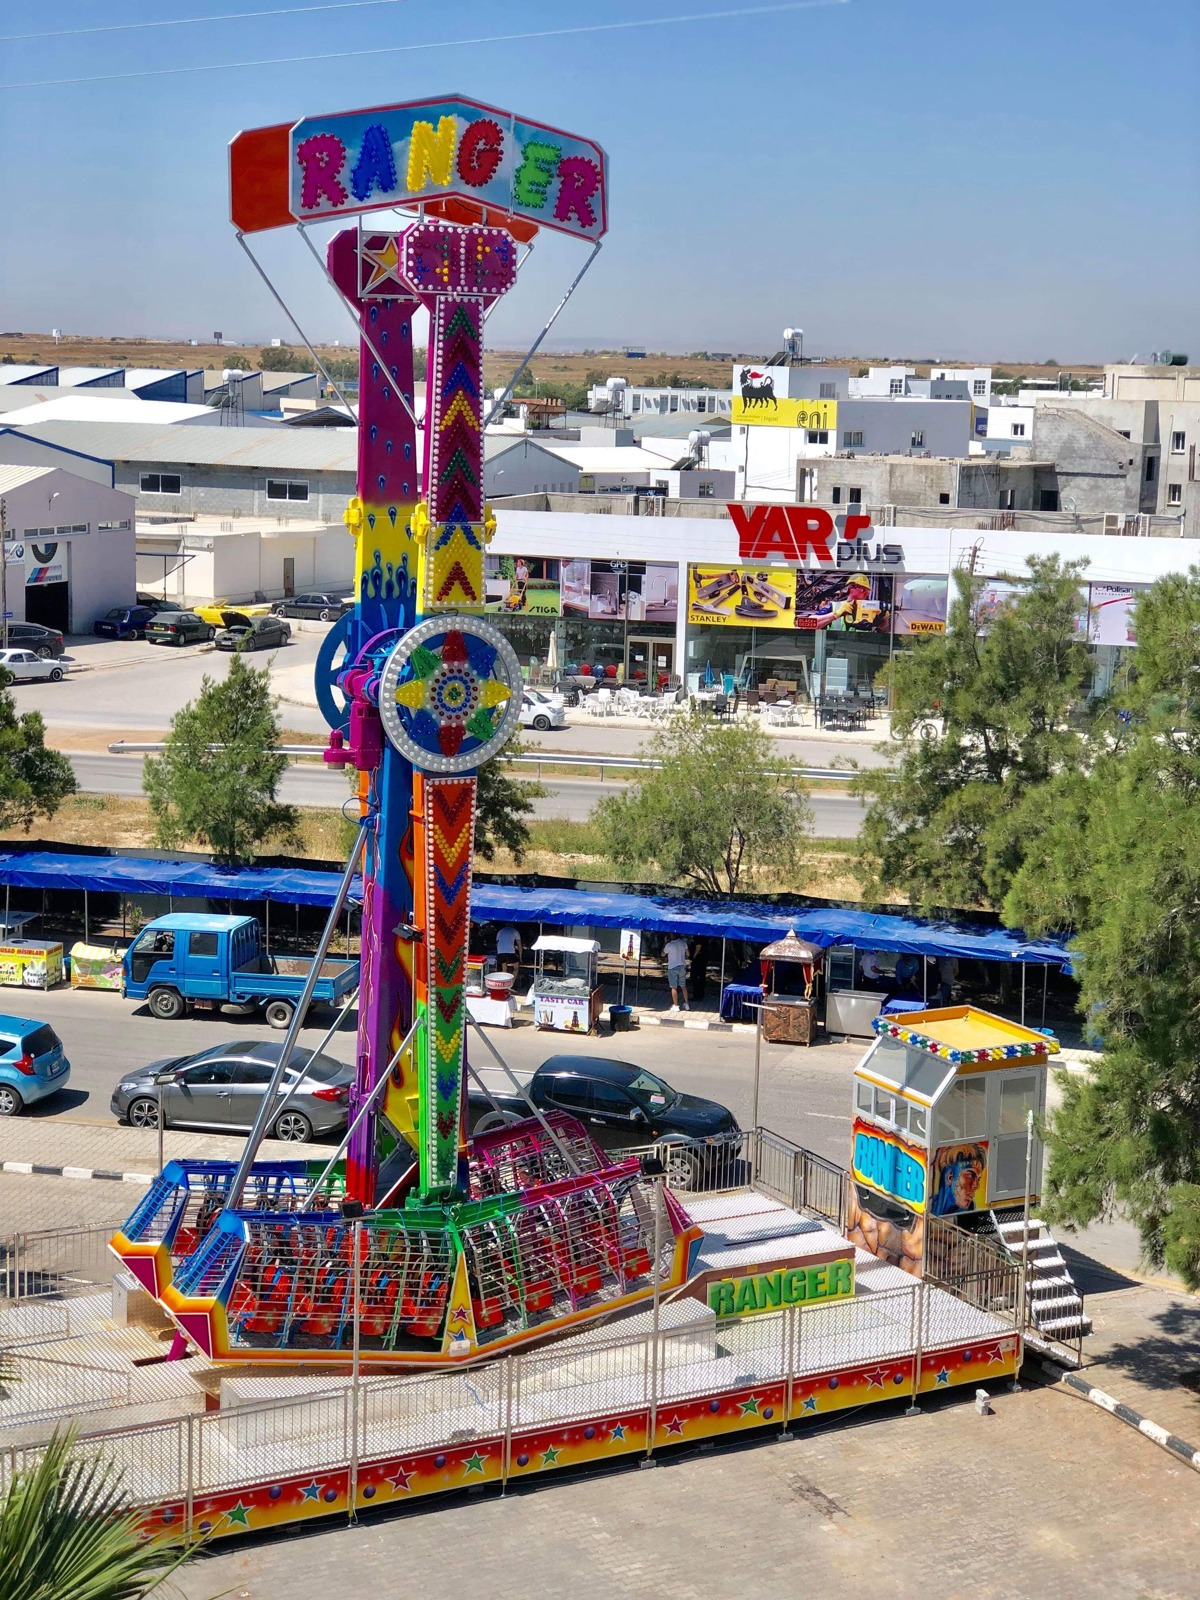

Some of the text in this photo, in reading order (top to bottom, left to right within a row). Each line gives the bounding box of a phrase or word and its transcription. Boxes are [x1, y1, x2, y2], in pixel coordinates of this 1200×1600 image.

[297, 115, 600, 228] RANGER
[797, 403, 828, 428] eni
[726, 504, 834, 561] YAR
[837, 538, 902, 568] plus
[529, 606, 558, 614] STIGA
[690, 614, 727, 623] STANLEY
[540, 996, 584, 1006] TASTY CAR
[854, 1133, 925, 1203] RANGER
[710, 1262, 852, 1315] RANGER
